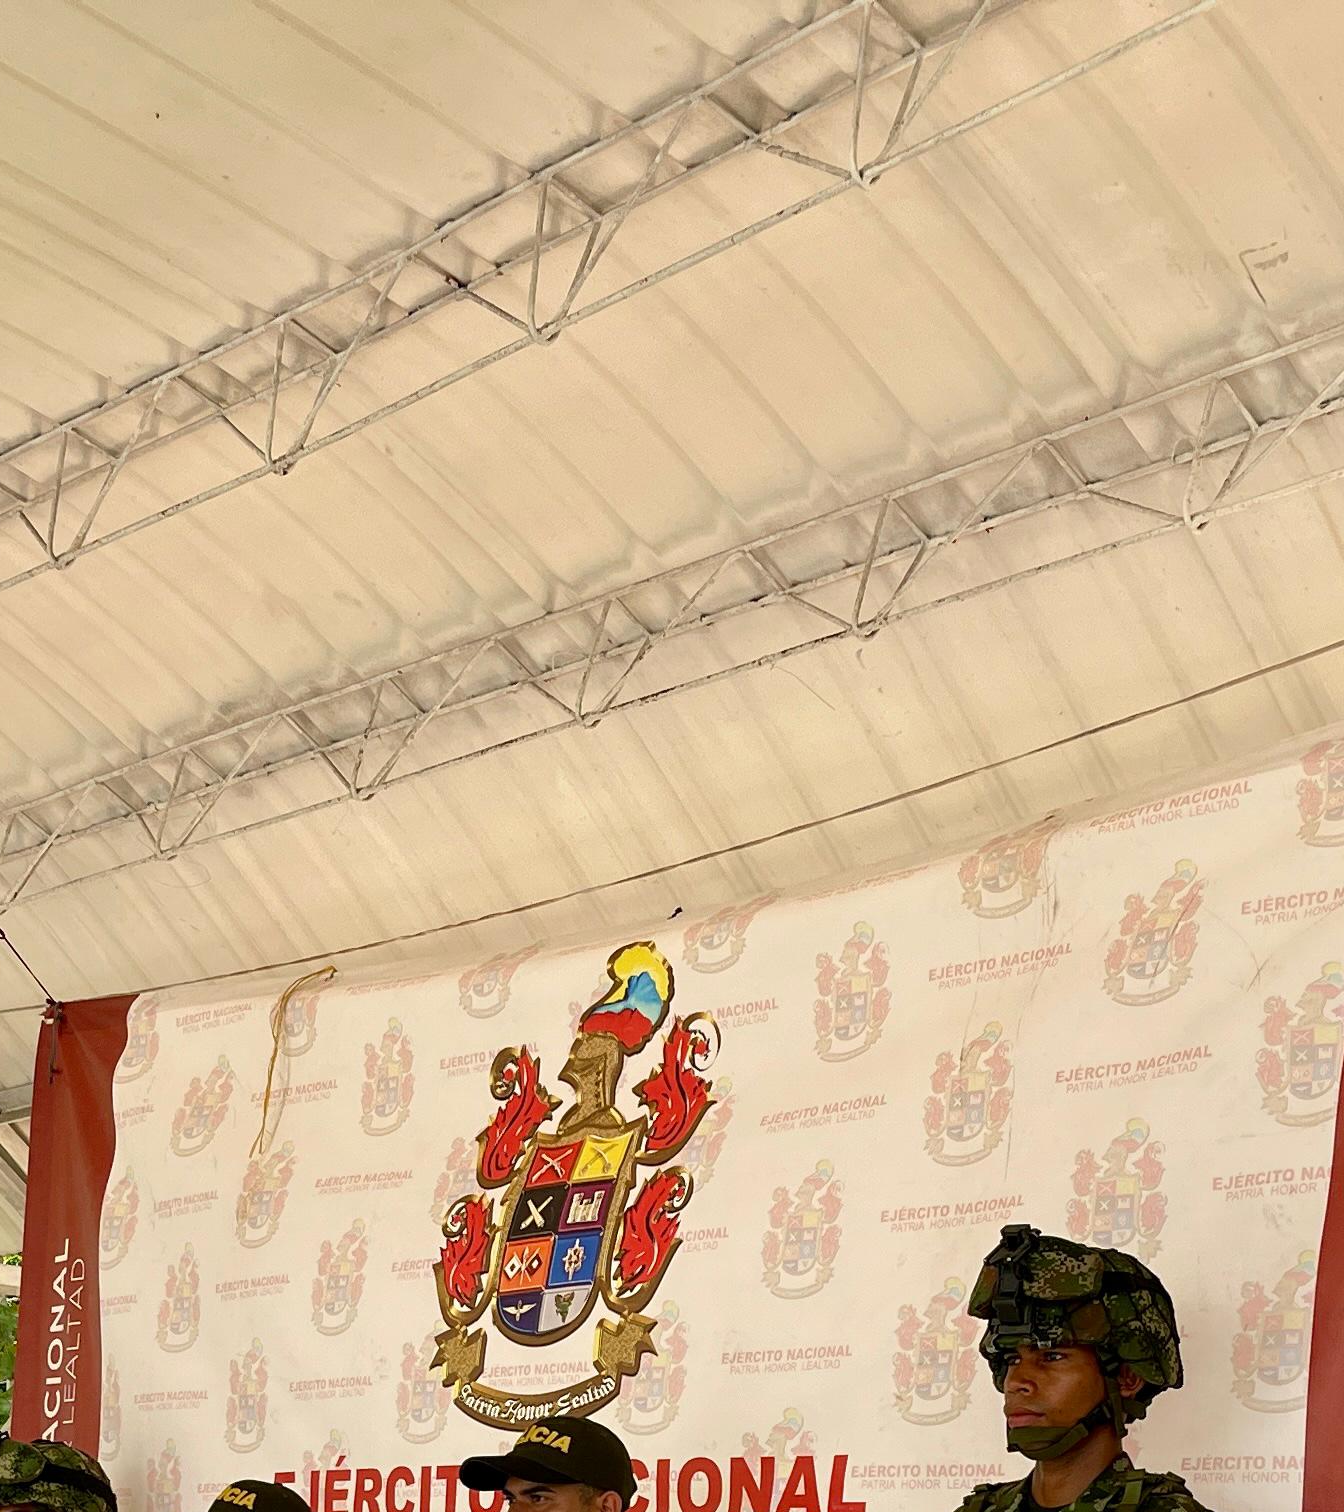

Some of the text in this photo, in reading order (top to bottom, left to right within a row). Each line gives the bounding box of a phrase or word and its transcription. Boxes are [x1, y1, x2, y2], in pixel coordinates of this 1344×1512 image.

[1169, 781, 1253, 809] NACIONAL
[1142, 809, 1184, 826] HONOR
[1189, 798, 1240, 818] LEALTAD
[1241, 890, 1329, 915] EJÉRCITO
[1256, 911, 1298, 925] PATRIA
[928, 943, 1073, 982] EJÉRCITO NACIONAL
[717, 998, 780, 1019] NACIONAL
[732, 1013, 770, 1029] LEALTAD
[1055, 1045, 1212, 1084] EJÉRCITO NACIONAL
[1066, 1061, 1198, 1093] PATRIA HONOR LEALTAD
[823, 1094, 888, 1115] NACIONAL
[1212, 1168, 1296, 1191] EJÉRCITO
[1225, 1183, 1318, 1202] PATRIA HONOR
[880, 1194, 1024, 1223] EJÉRCITO NACIONAL
[891, 1209, 1011, 1233] PATRIA HONOR LEALTAD
[679, 1227, 729, 1243] ACIONAL
[41, 1238, 70, 1442] ACIONAL
[63, 1257, 86, 1425] LEALTAD
[787, 1344, 853, 1360] NACIONAL
[535, 1360, 590, 1375] NACIONAL
[517, 1424, 572, 1454] ICIA
[851, 1462, 1005, 1478] EJÉRCITO NACIONAL
[1181, 1453, 1266, 1471] EJÉRCITO
[861, 1479, 896, 1489] PATRIA
[901, 1479, 941, 1489] HONOR
[1193, 1471, 1290, 1484] PATRIA HONOR
